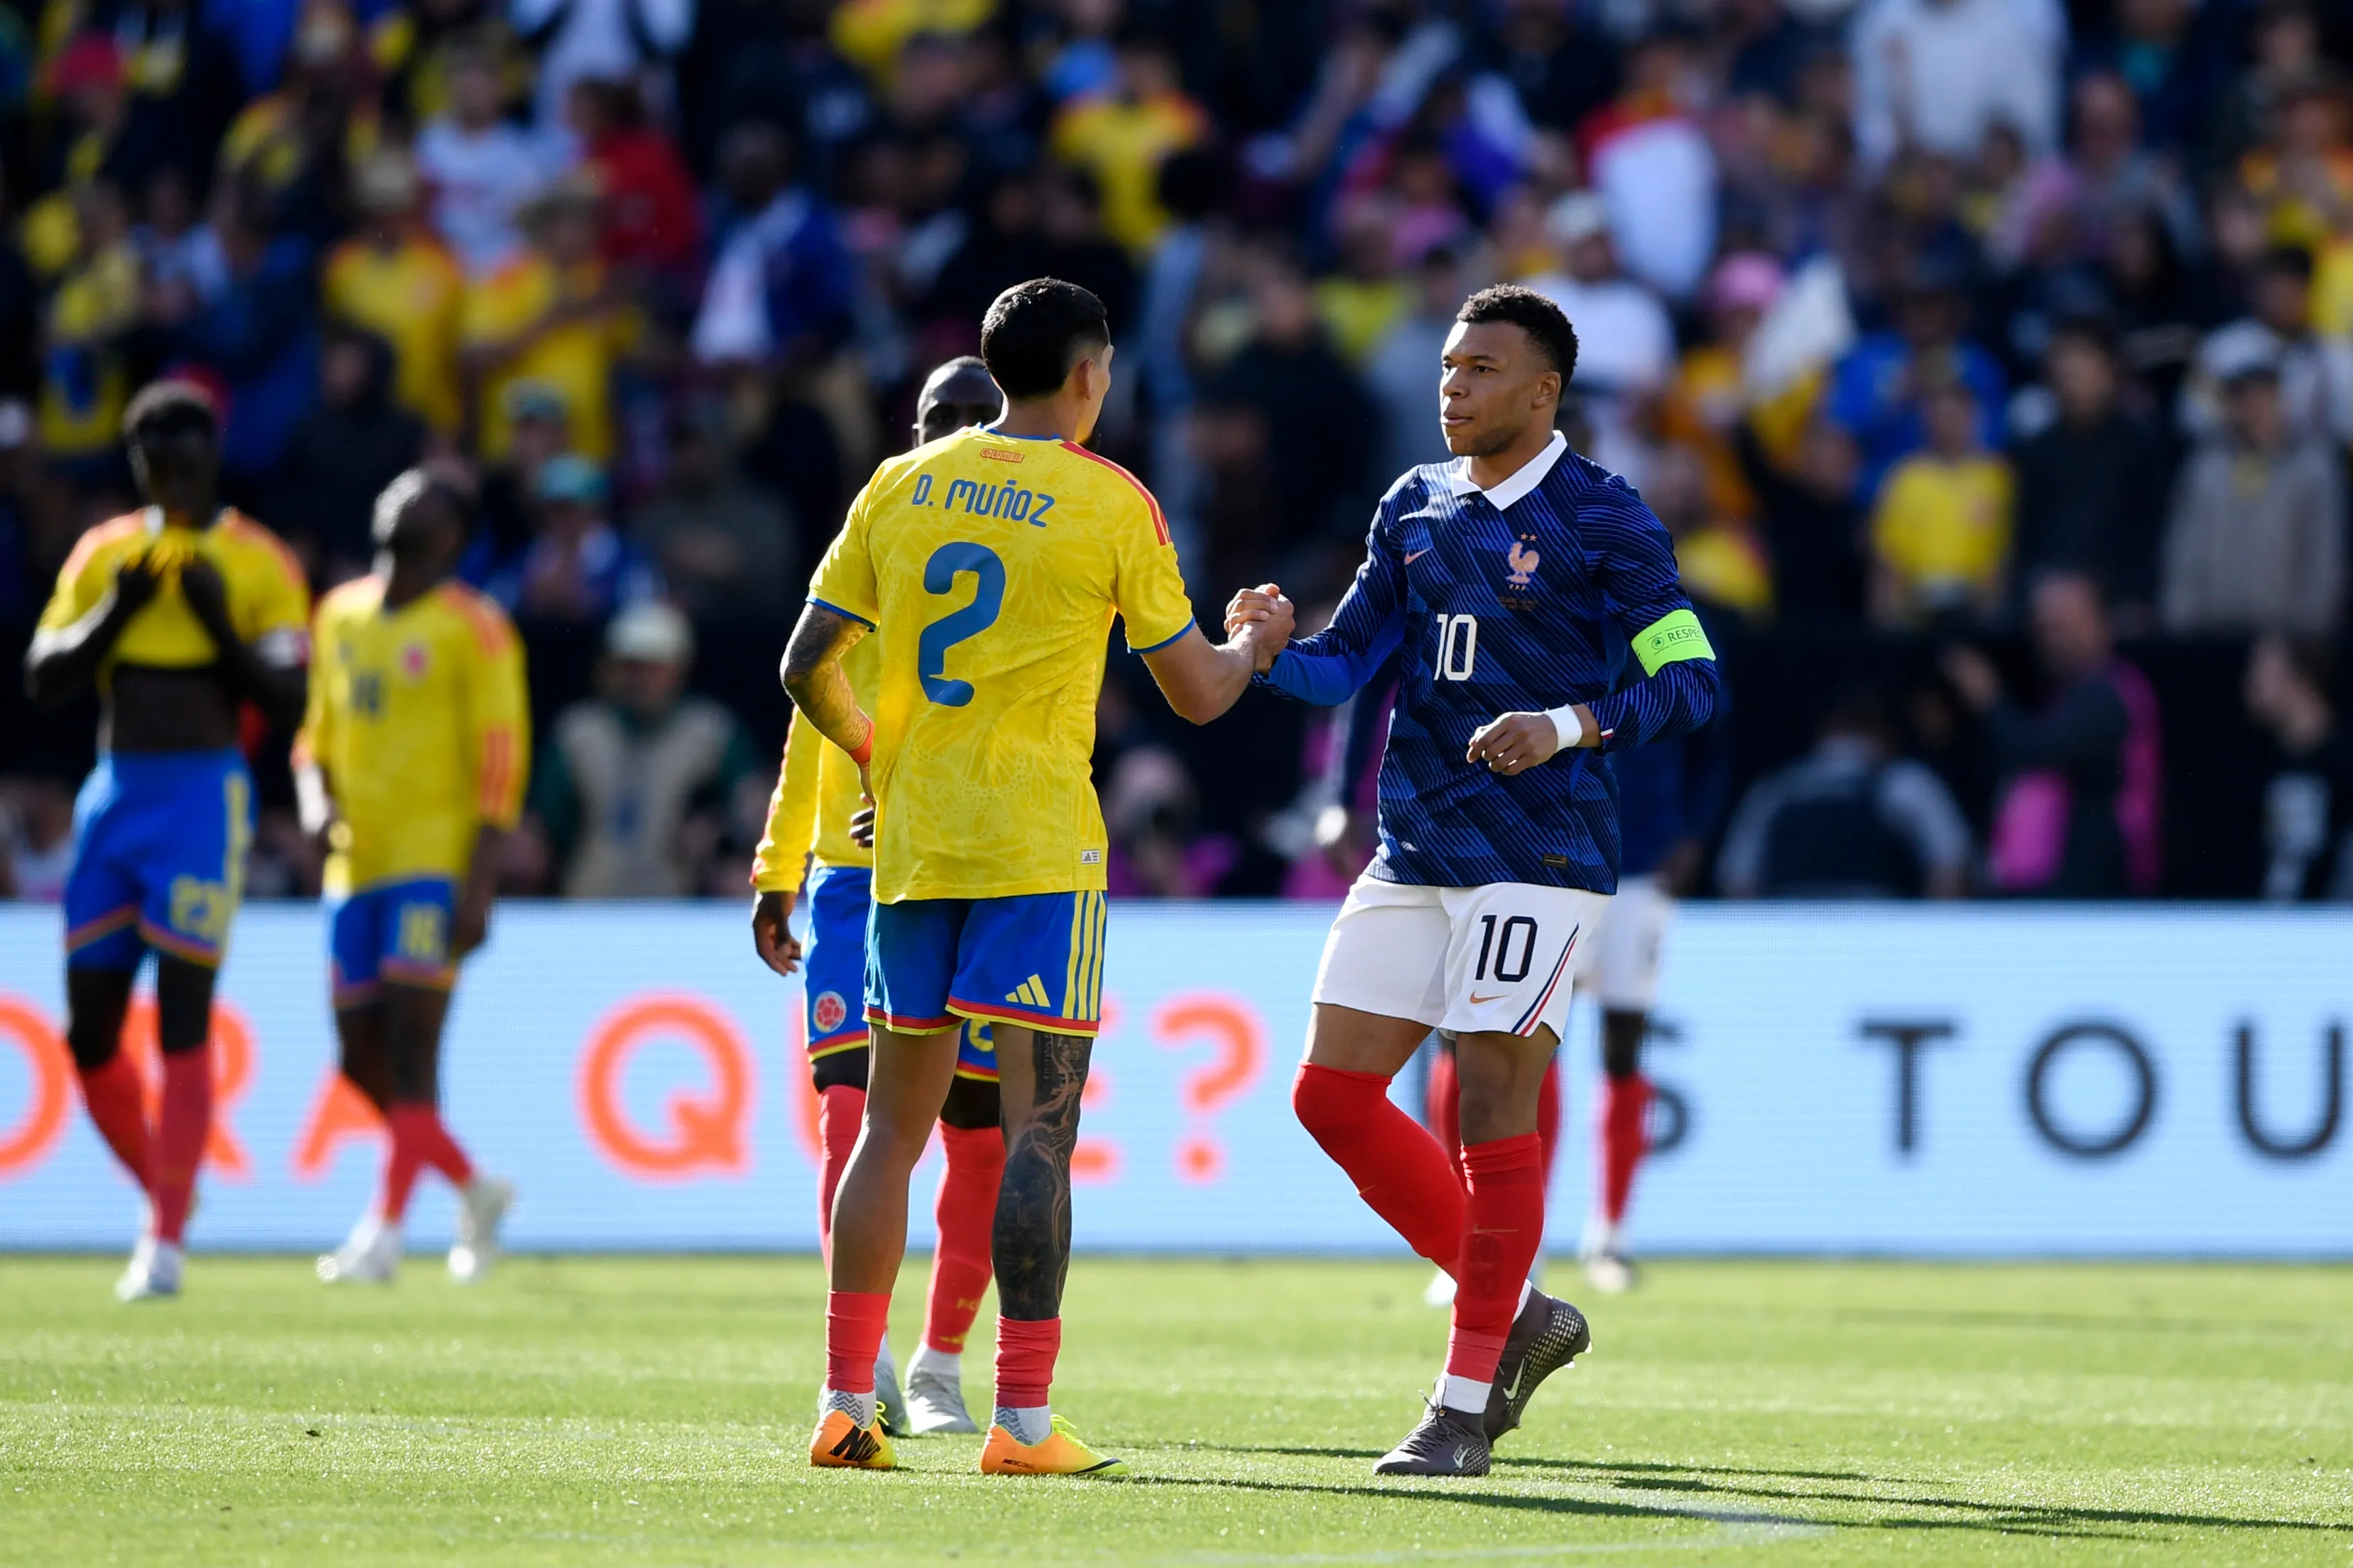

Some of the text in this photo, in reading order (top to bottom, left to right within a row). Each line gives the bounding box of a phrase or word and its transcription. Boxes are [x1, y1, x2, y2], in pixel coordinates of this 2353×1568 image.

[980, 448, 1025, 463] COLOMBIA
[912, 474, 1055, 528] D. MUÑOZ
[918, 541, 1006, 707] 2
[1434, 614, 1477, 680] 10
[1475, 914, 1538, 982] 10
[1855, 1018, 2347, 1160] TOU
